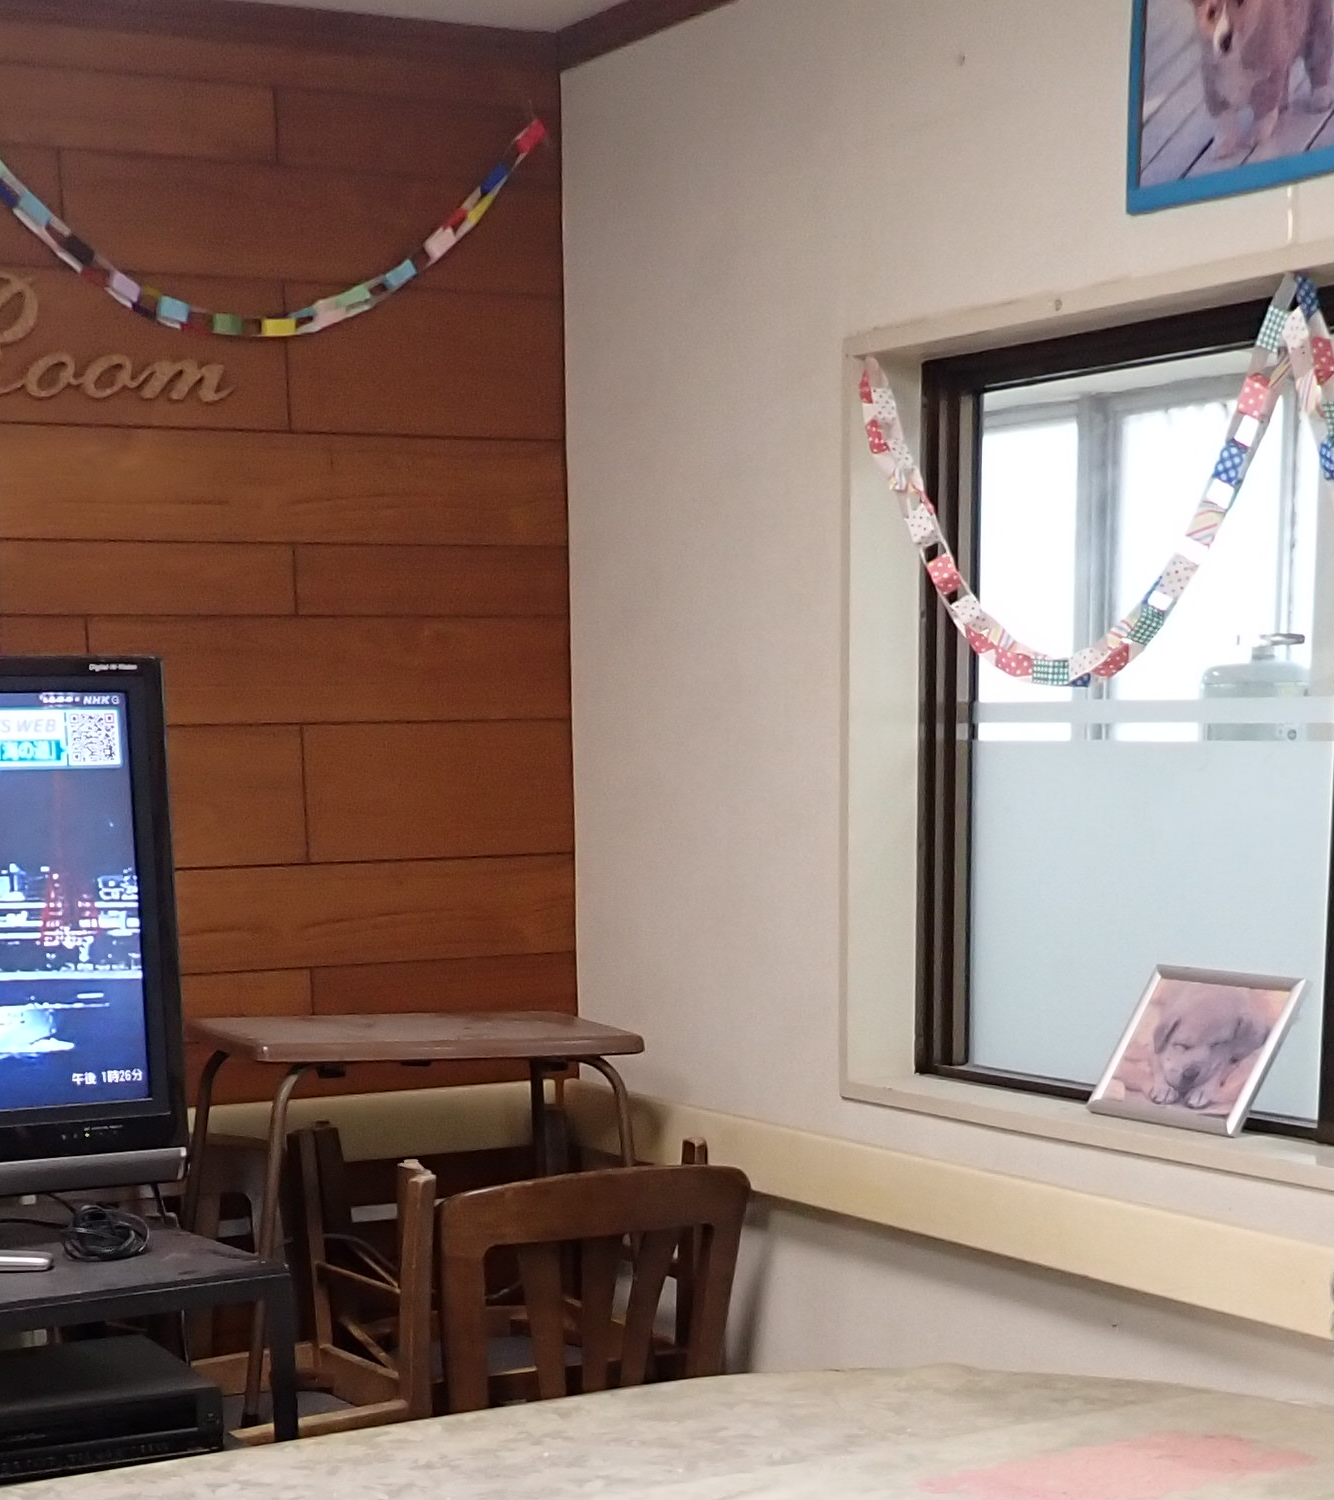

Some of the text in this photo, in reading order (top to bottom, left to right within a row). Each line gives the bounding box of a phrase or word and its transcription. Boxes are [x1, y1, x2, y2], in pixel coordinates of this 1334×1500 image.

[83, 695, 110, 705] NHK
[16, 716, 57, 734] WEB
[71, 1068, 144, 1086] 午後 1時26分
